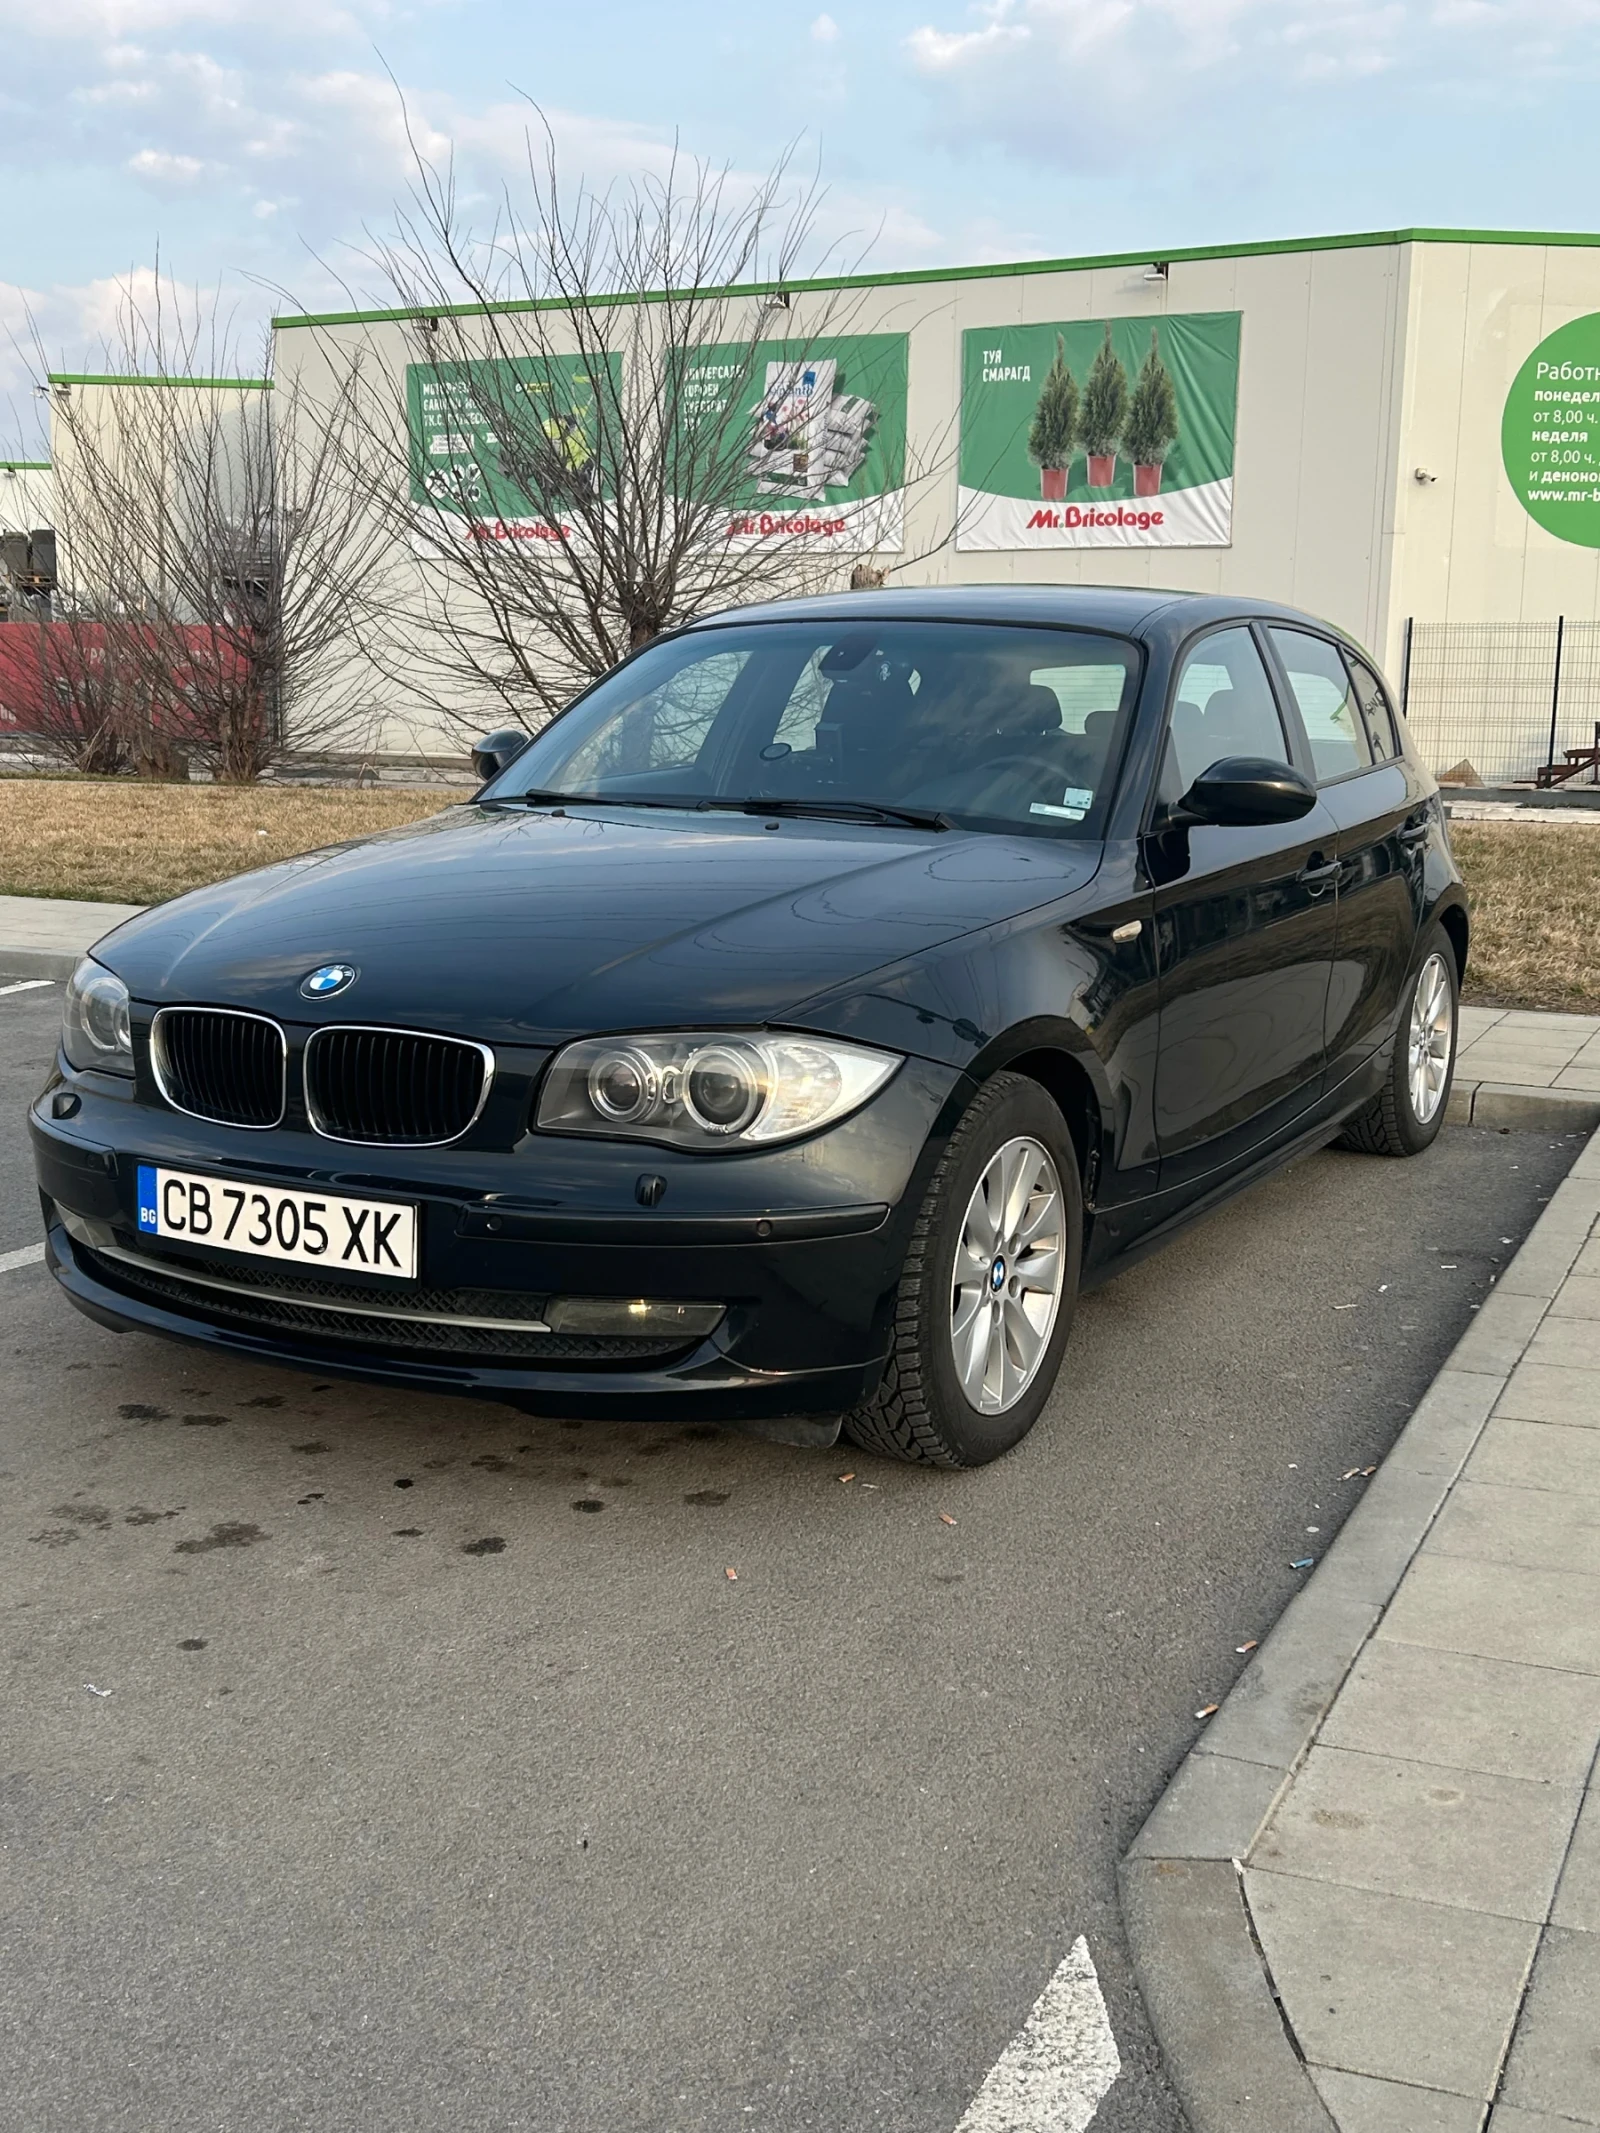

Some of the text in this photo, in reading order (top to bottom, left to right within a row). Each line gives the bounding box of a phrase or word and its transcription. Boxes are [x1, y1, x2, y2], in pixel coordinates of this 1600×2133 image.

[983, 349, 1002, 365] ТУЯ
[982, 365, 1031, 383] СМАРАГД
[1533, 409, 1598, 425] от 8,00 ч.
[1531, 430, 1588, 444] неделя
[1531, 451, 1548, 463] от
[1550, 449, 1581, 465] 8,00
[1529, 471, 1600, 484] и деноно
[140, 1206, 157, 1224] BG
[163, 1179, 402, 1268] CB 7305 XK
